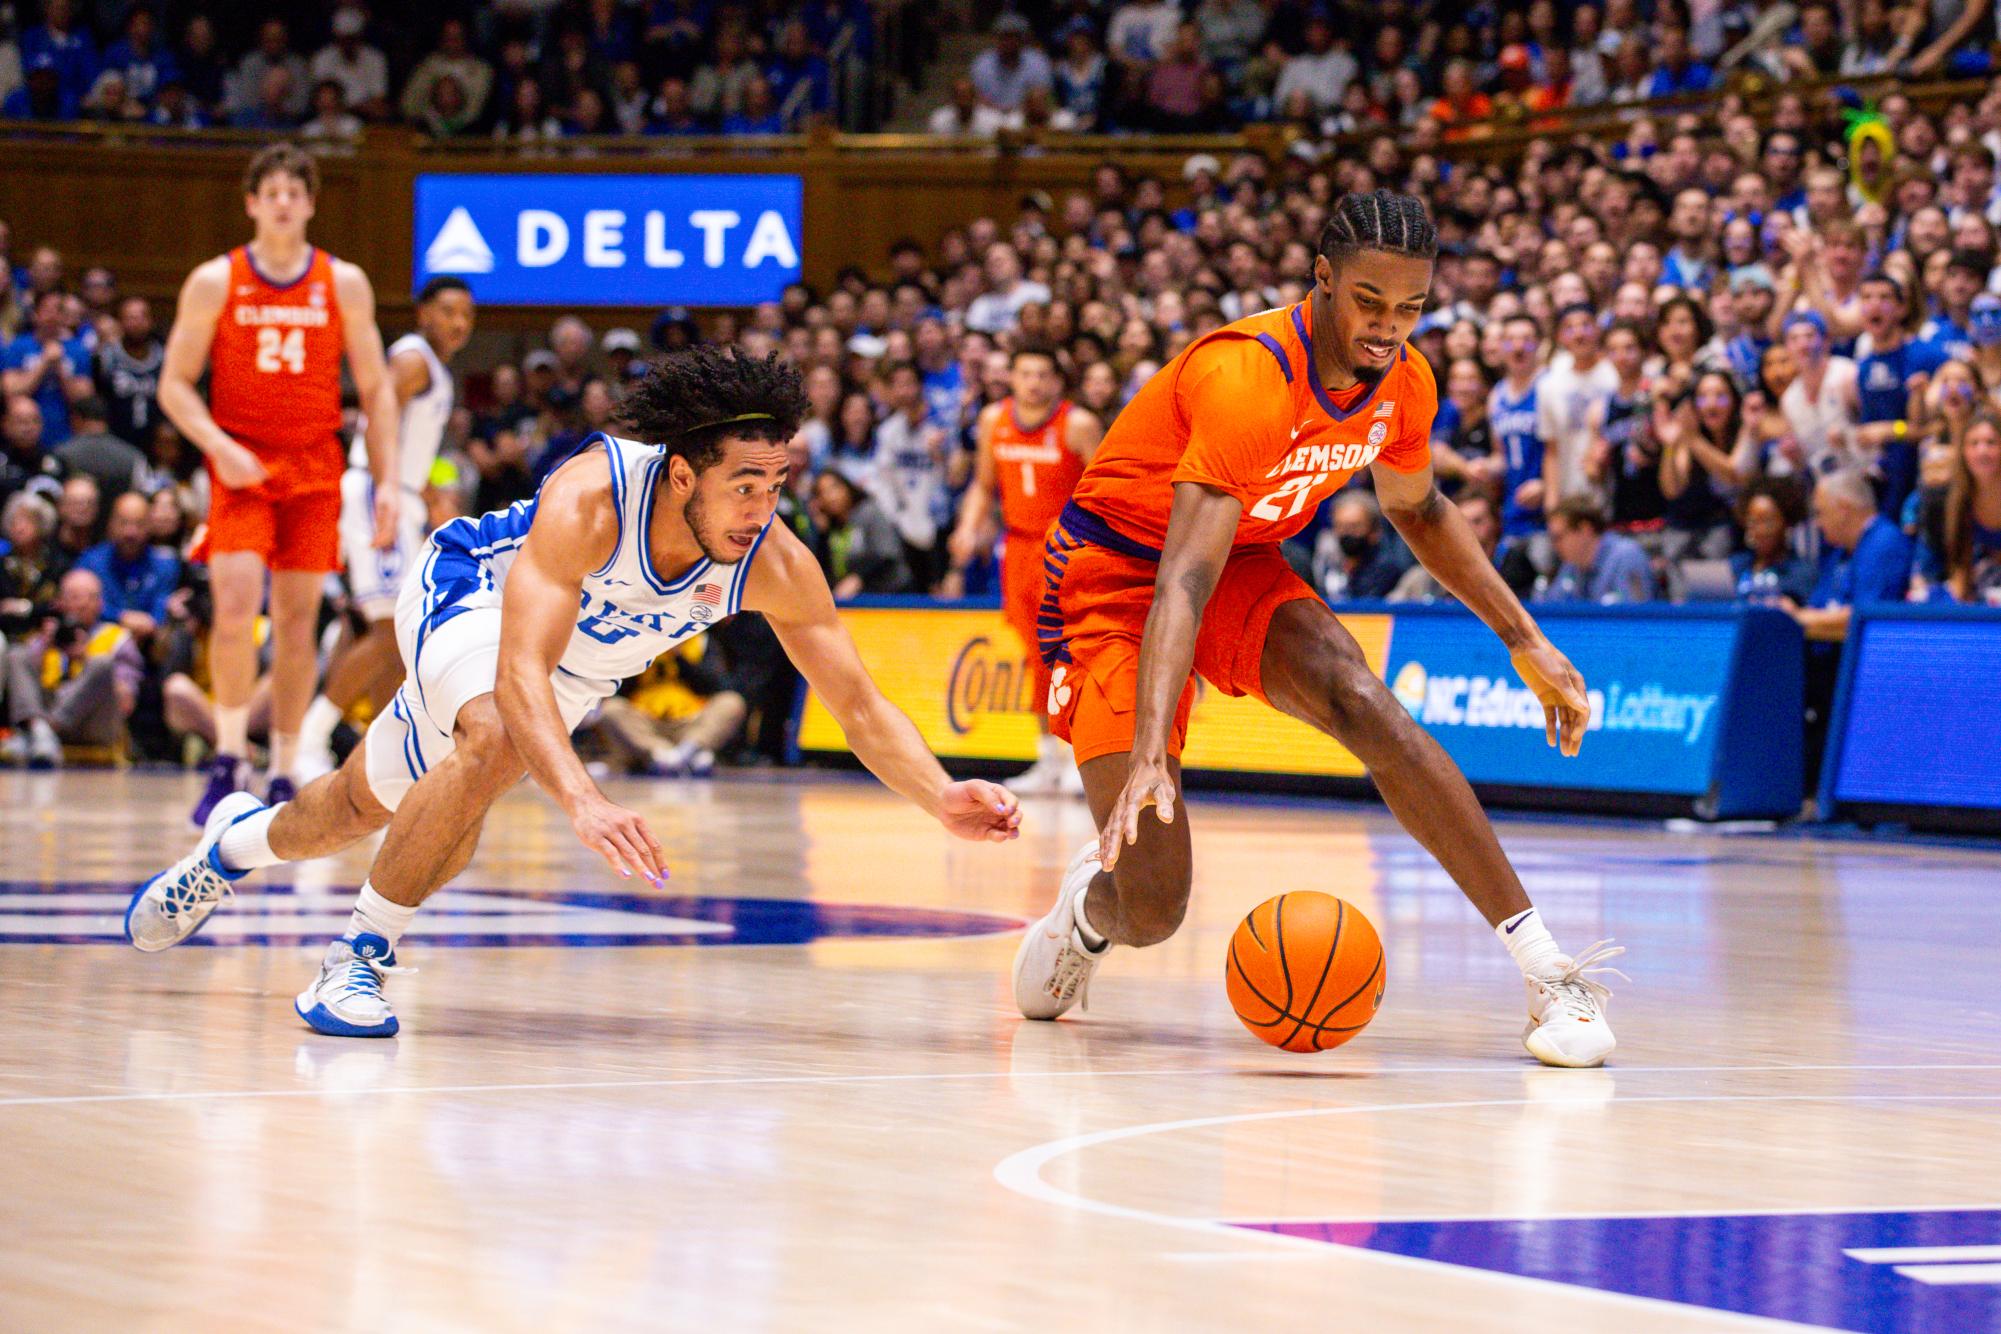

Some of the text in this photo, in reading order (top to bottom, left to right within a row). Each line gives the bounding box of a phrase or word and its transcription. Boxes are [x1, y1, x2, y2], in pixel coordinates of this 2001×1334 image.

[516, 209, 799, 269] DELTA
[258, 328, 305, 374] 24
[1021, 462, 1035, 497] 1
[1249, 473, 1328, 512] 21
[1422, 676, 1467, 725] NC
[1604, 680, 1717, 745] Lottery
